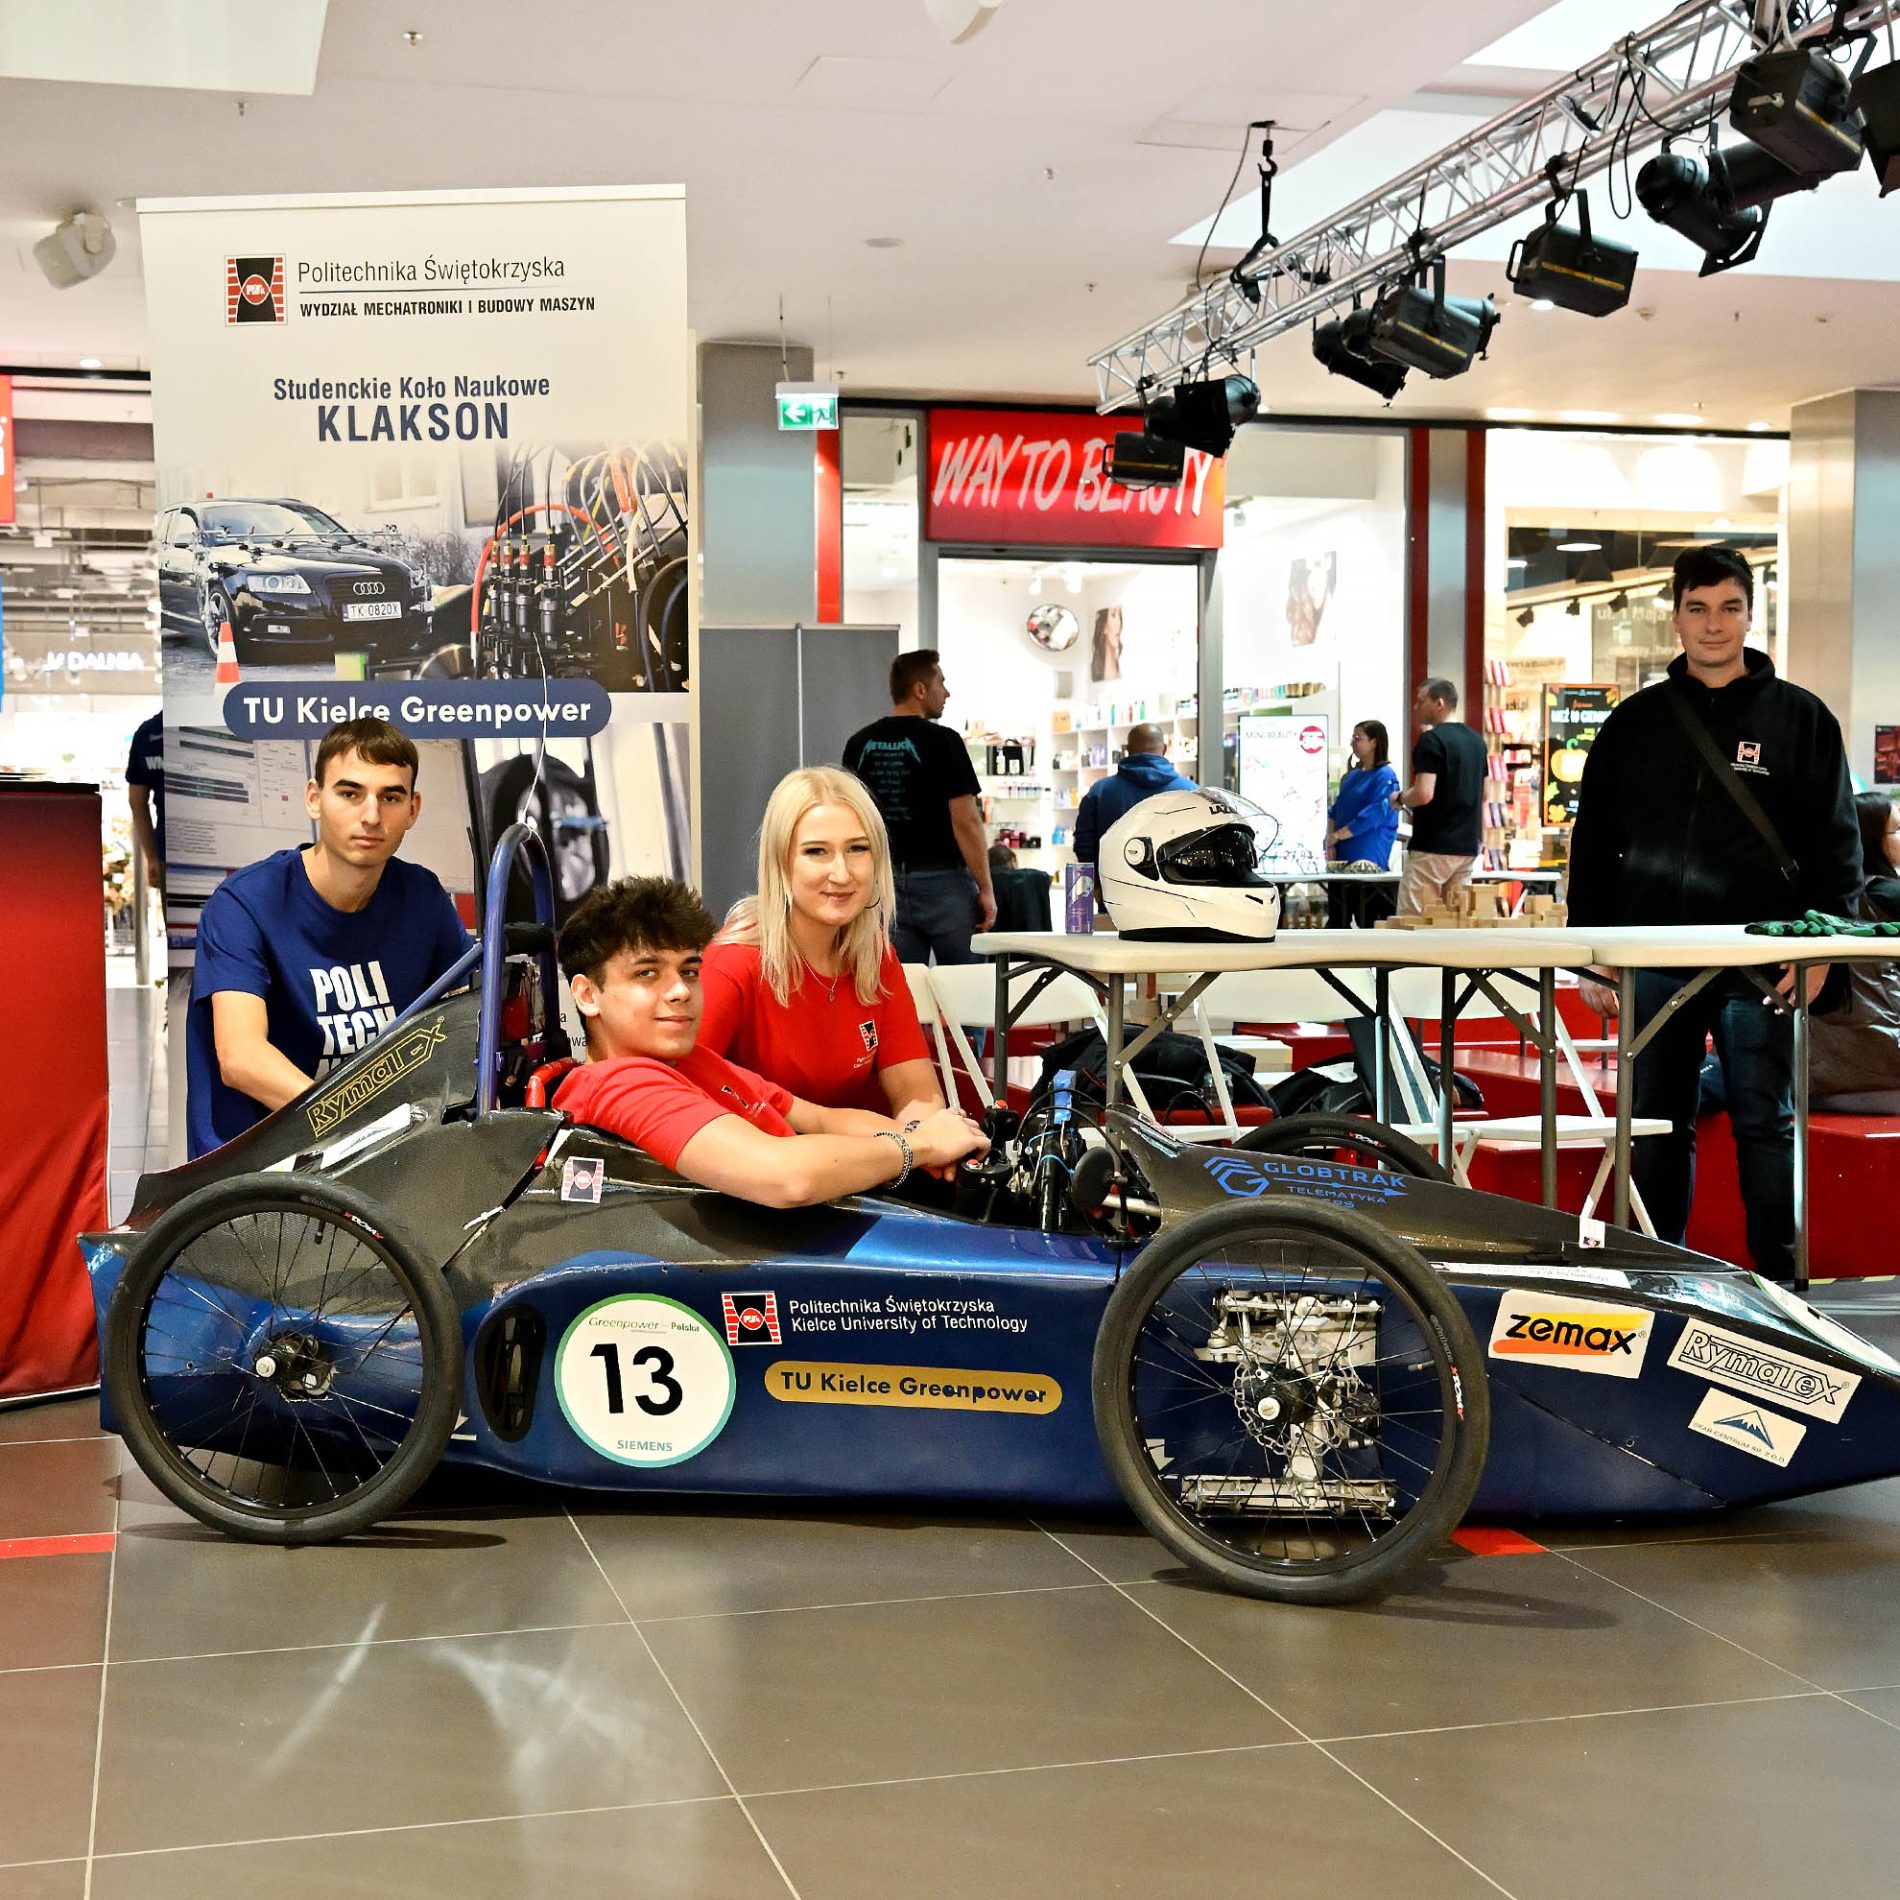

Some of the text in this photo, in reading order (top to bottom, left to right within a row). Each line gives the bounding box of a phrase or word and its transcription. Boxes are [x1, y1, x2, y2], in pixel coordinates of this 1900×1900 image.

[299, 254, 565, 284] Politechnika Świętokrzyska
[299, 296, 595, 318] WYDZIAŁ MECHATRONIKI I BUDOWY MASZYN
[273, 375, 551, 401] Studenckie Koło Naukowe
[317, 402, 509, 443] KLAKSON
[932, 433, 1024, 509] WAY
[1017, 437, 1072, 512] TO
[350, 605, 365, 618] TK
[243, 694, 592, 730] TU Kielce Greenpower
[309, 960, 391, 1014] POLI
[1263, 1161, 1406, 1188] GLOBTRAK
[1287, 1185, 1388, 1204] TELEMATYKA
[788, 1294, 995, 1317] Politechnika Świętokrzyska
[588, 1316, 700, 1332] Greenpower Polska
[791, 1313, 1029, 1335] Kielce University of Technology
[1505, 1313, 1637, 1356] zemax
[589, 1342, 684, 1417] 13
[780, 1370, 1048, 1405] TU Kielce Greenpower
[616, 1438, 673, 1453] SIEMENS
[1713, 1430, 1751, 1448] CENTRUM
